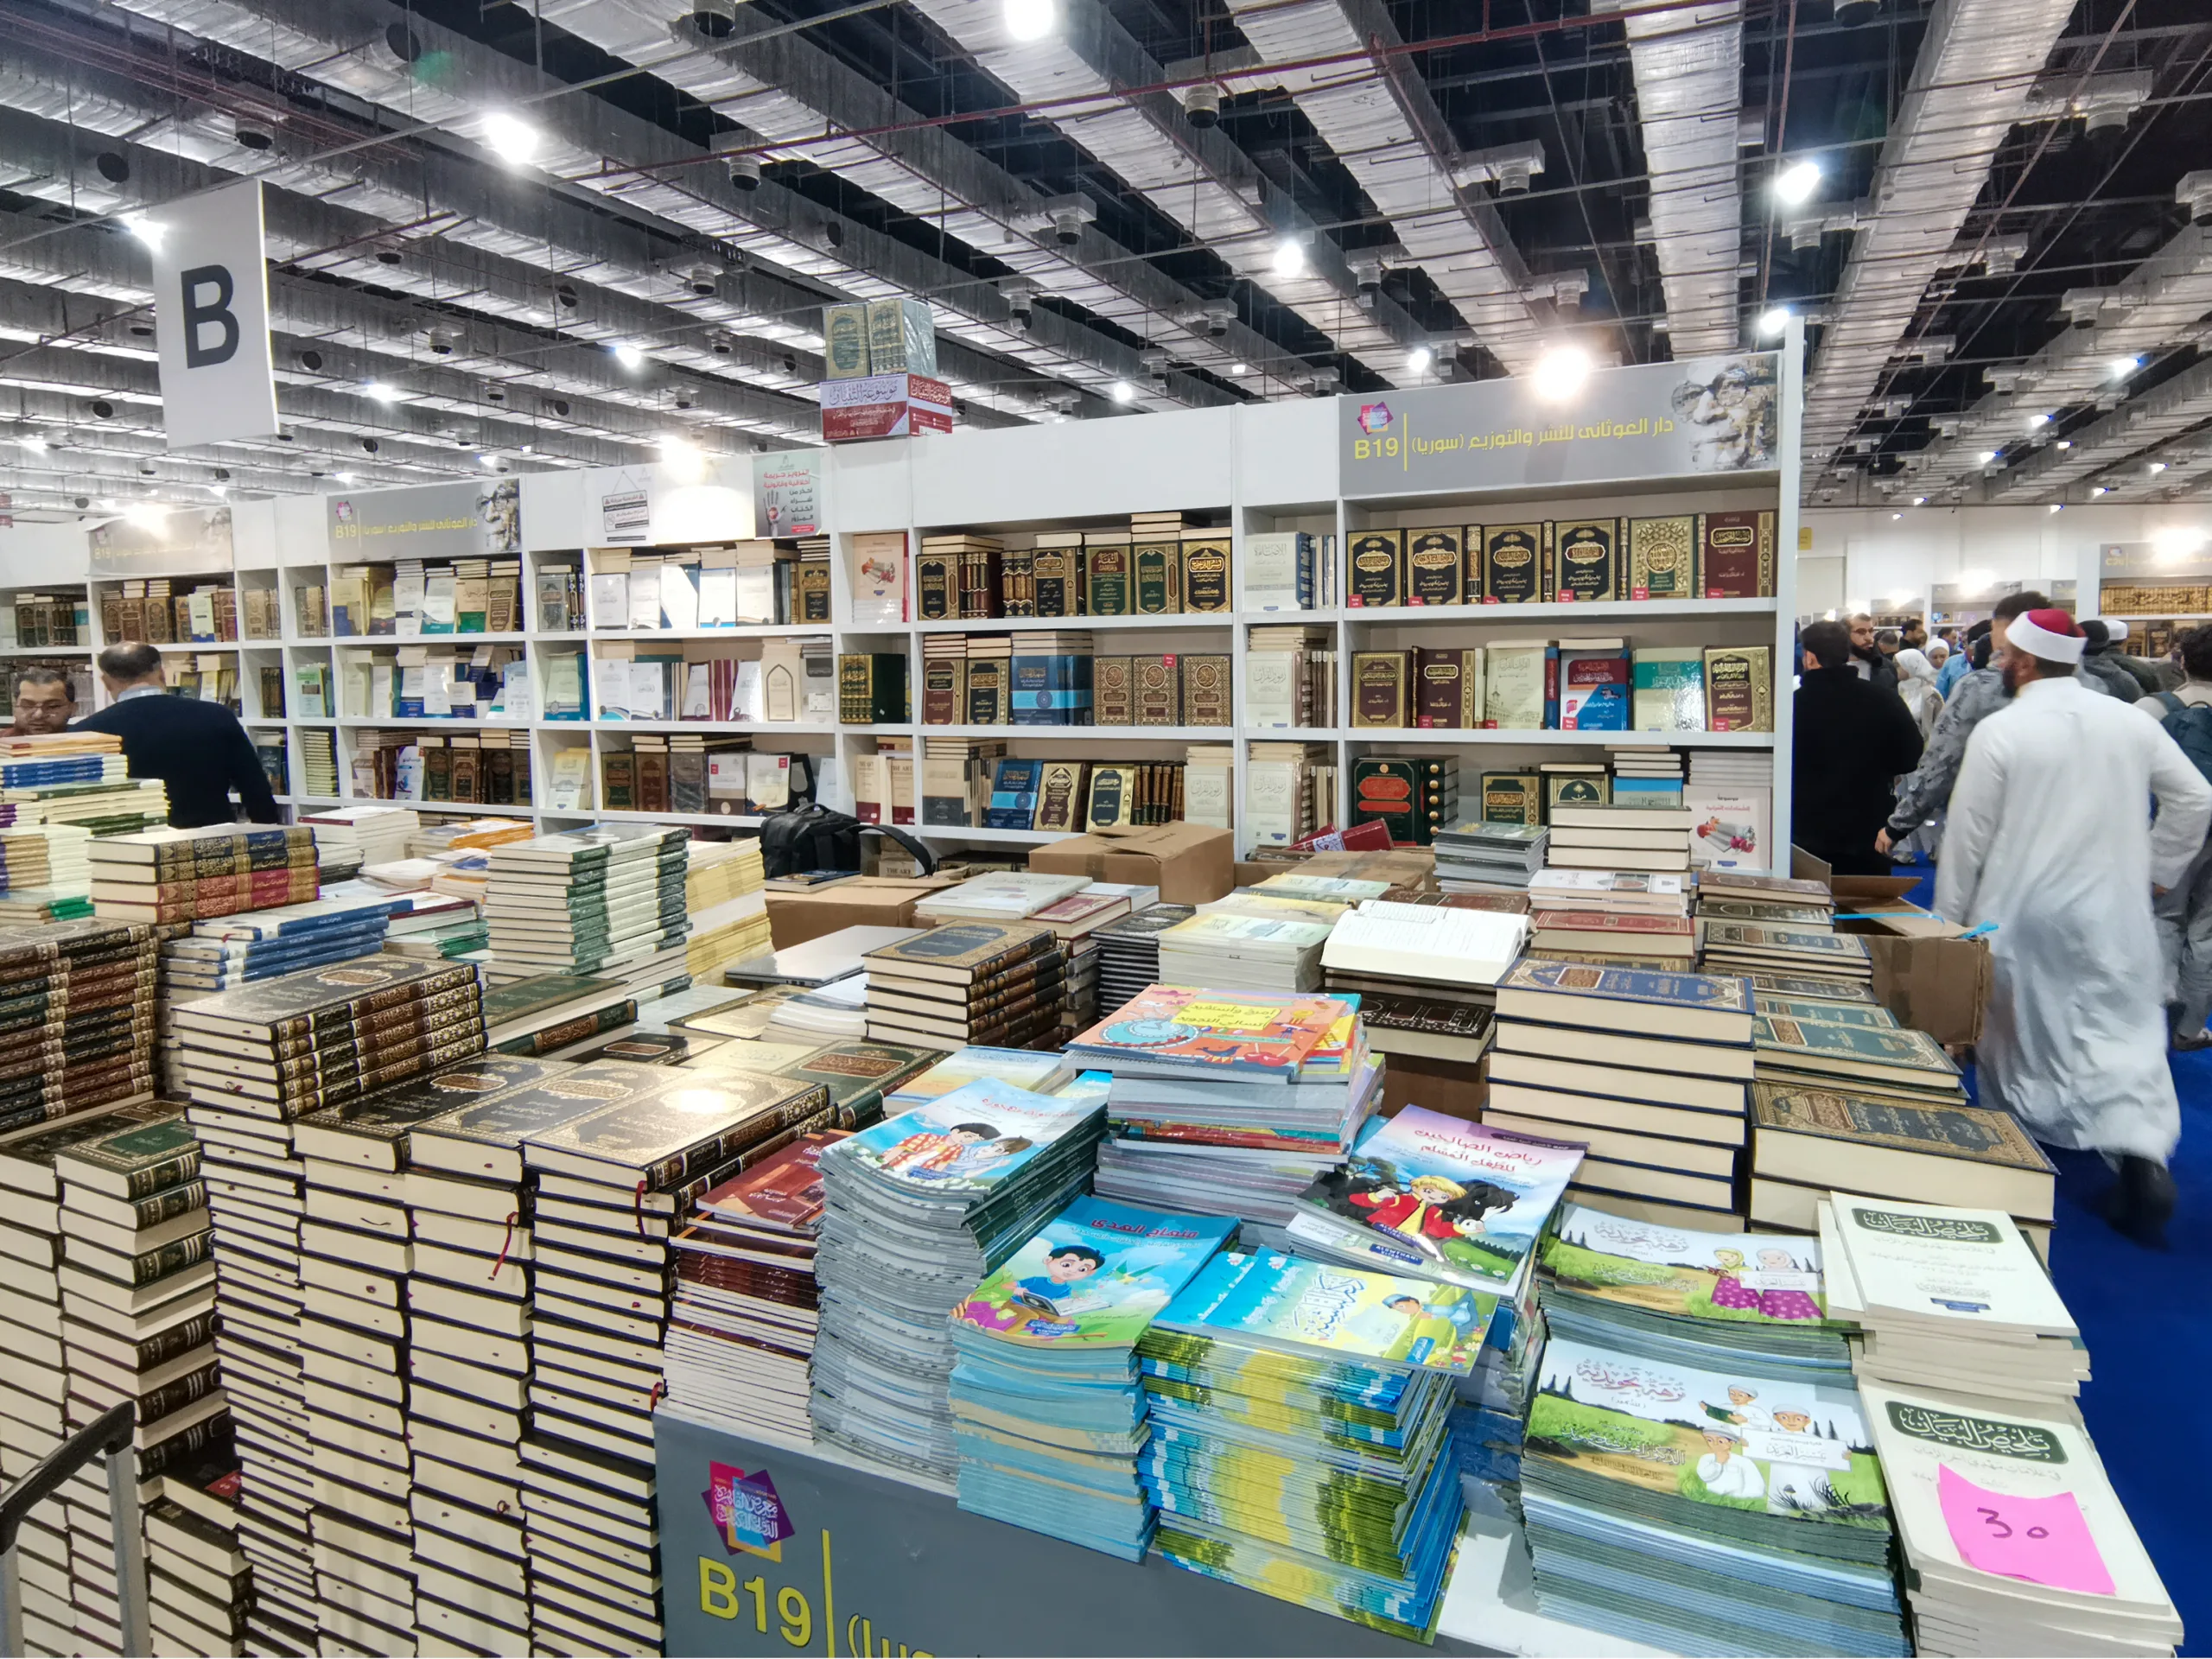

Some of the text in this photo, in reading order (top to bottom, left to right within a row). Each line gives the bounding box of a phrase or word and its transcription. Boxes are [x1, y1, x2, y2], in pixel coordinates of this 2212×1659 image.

[181, 264, 240, 369] B
[1536, 424, 1573, 447] للنشر
[1652, 416, 1674, 437] دار
[1354, 438, 1398, 459] B19
[1468, 429, 1533, 451] والتوزيع
[335, 524, 357, 538] B19
[1145, 1227, 1198, 1239] منهاج
[698, 1555, 812, 1647] B19
